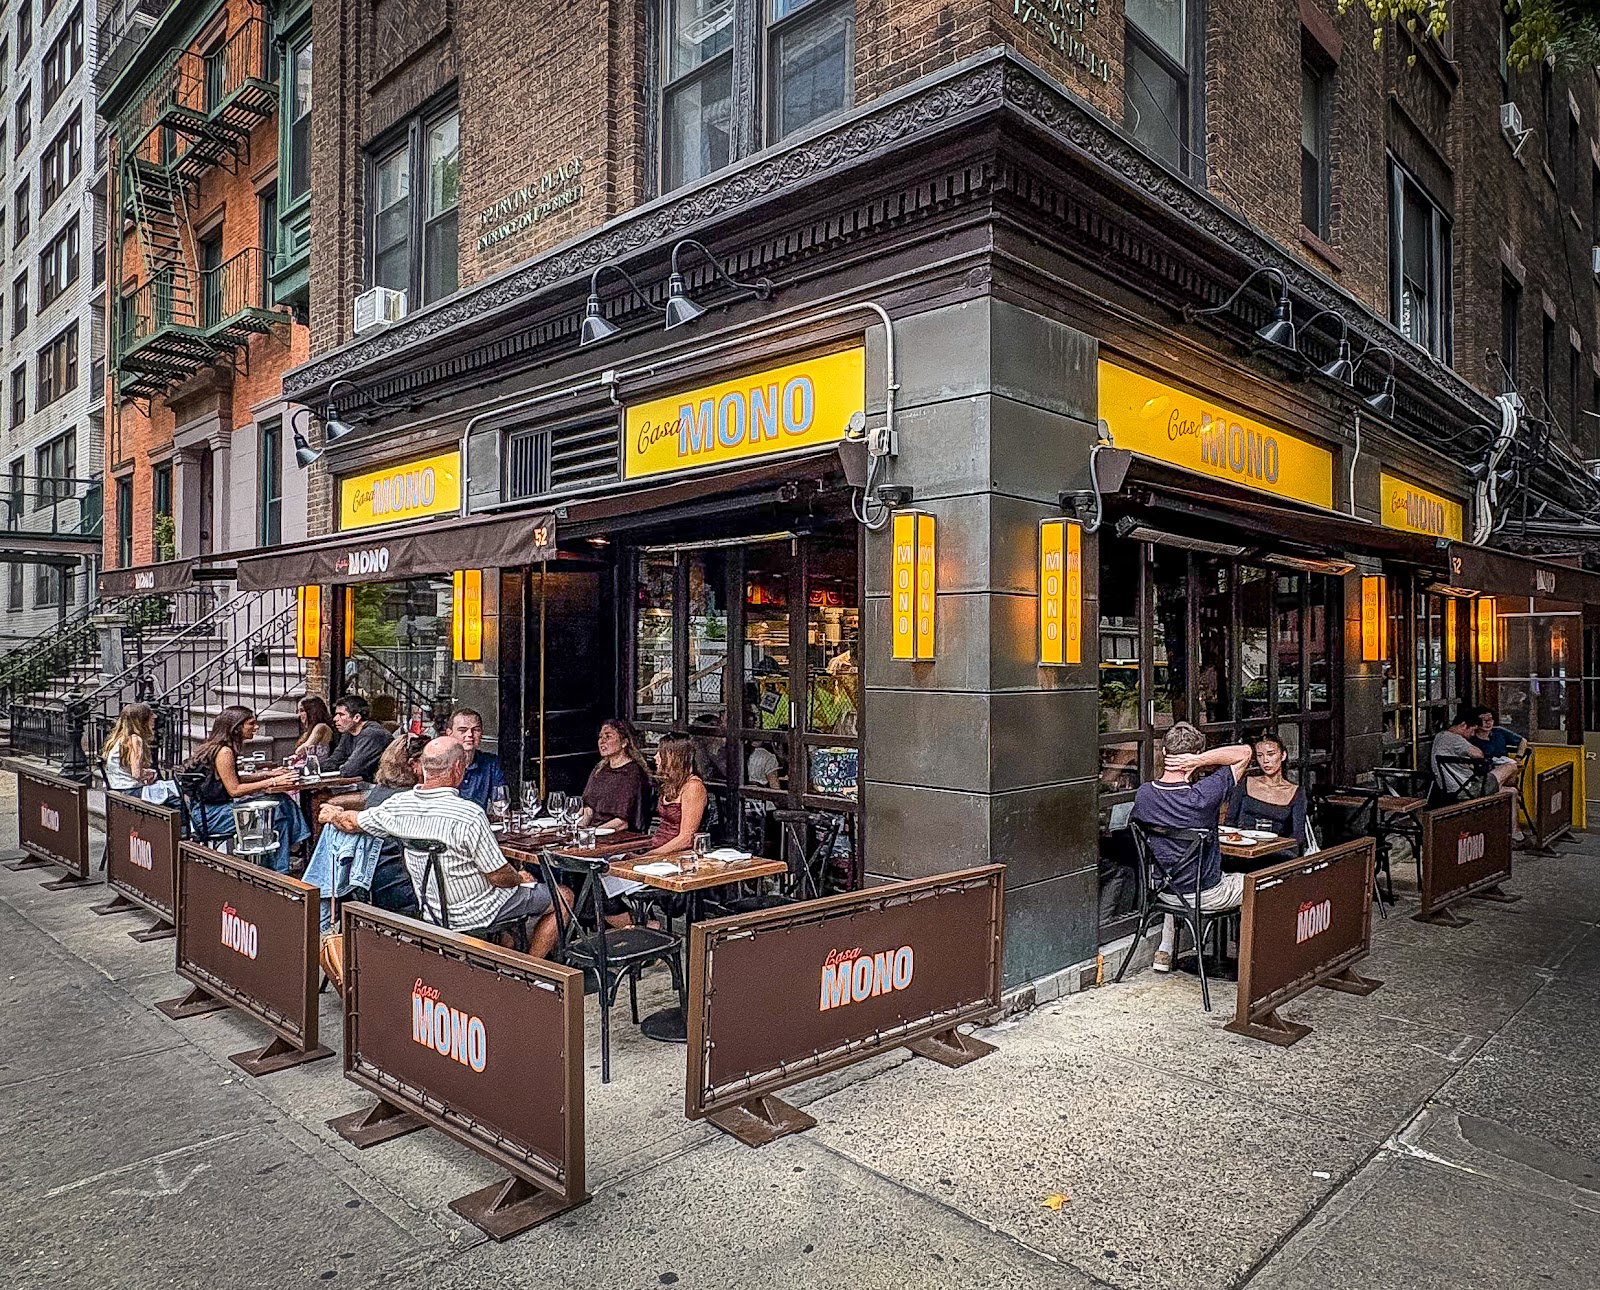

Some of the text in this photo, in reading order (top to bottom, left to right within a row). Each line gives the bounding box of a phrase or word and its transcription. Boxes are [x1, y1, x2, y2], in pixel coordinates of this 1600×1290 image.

[496, 182, 539, 219] IRVING
[541, 155, 585, 194] PLACE
[637, 374, 816, 458] Casa MONO
[1200, 410, 1279, 485] MONO
[372, 466, 436, 517] MONO
[1406, 490, 1445, 536] MONO
[347, 546, 390, 576] MONO
[533, 526, 548, 548] 52
[897, 544, 912, 635] MONO
[919, 545, 933, 636] MONO
[1044, 551, 1061, 641] MONO
[1066, 551, 1080, 641] MONO
[129, 835, 153, 871] MONO
[1457, 832, 1485, 865] MONO
[220, 910, 258, 960] MONO
[1296, 898, 1331, 944] MONO
[819, 945, 915, 1012] MONO
[824, 947, 861, 966] Casa
[413, 977, 441, 1000] Casa
[411, 991, 487, 1073] MONO
